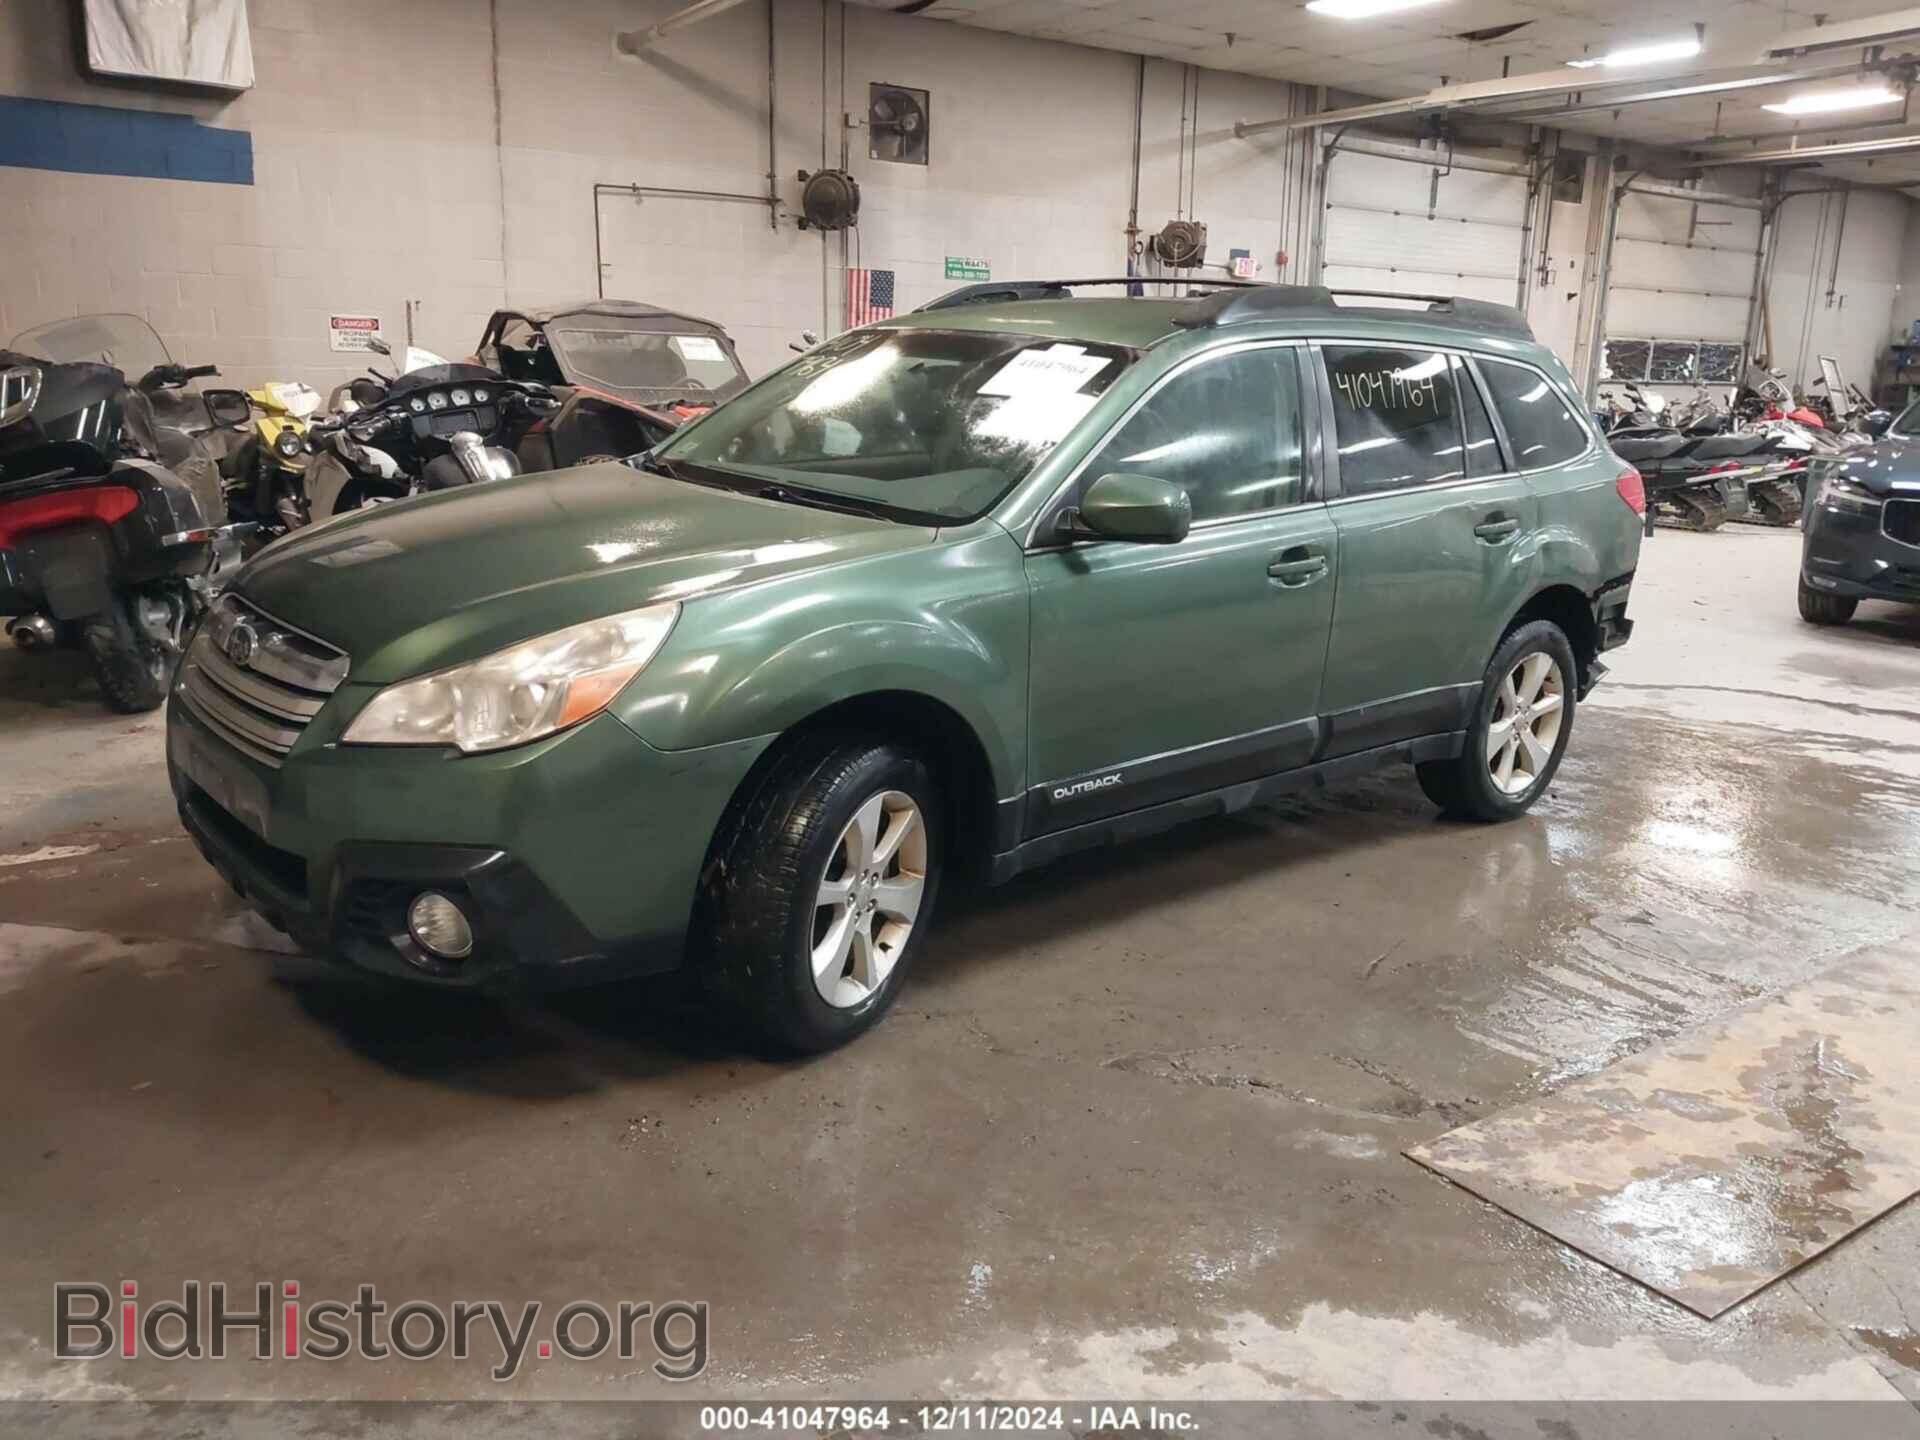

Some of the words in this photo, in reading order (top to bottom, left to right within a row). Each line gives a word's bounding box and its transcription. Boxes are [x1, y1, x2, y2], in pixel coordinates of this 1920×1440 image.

[338, 319, 372, 329] DANGER
[1335, 367, 1440, 416] 41047964
[1054, 773, 1123, 799] OUTBACK
